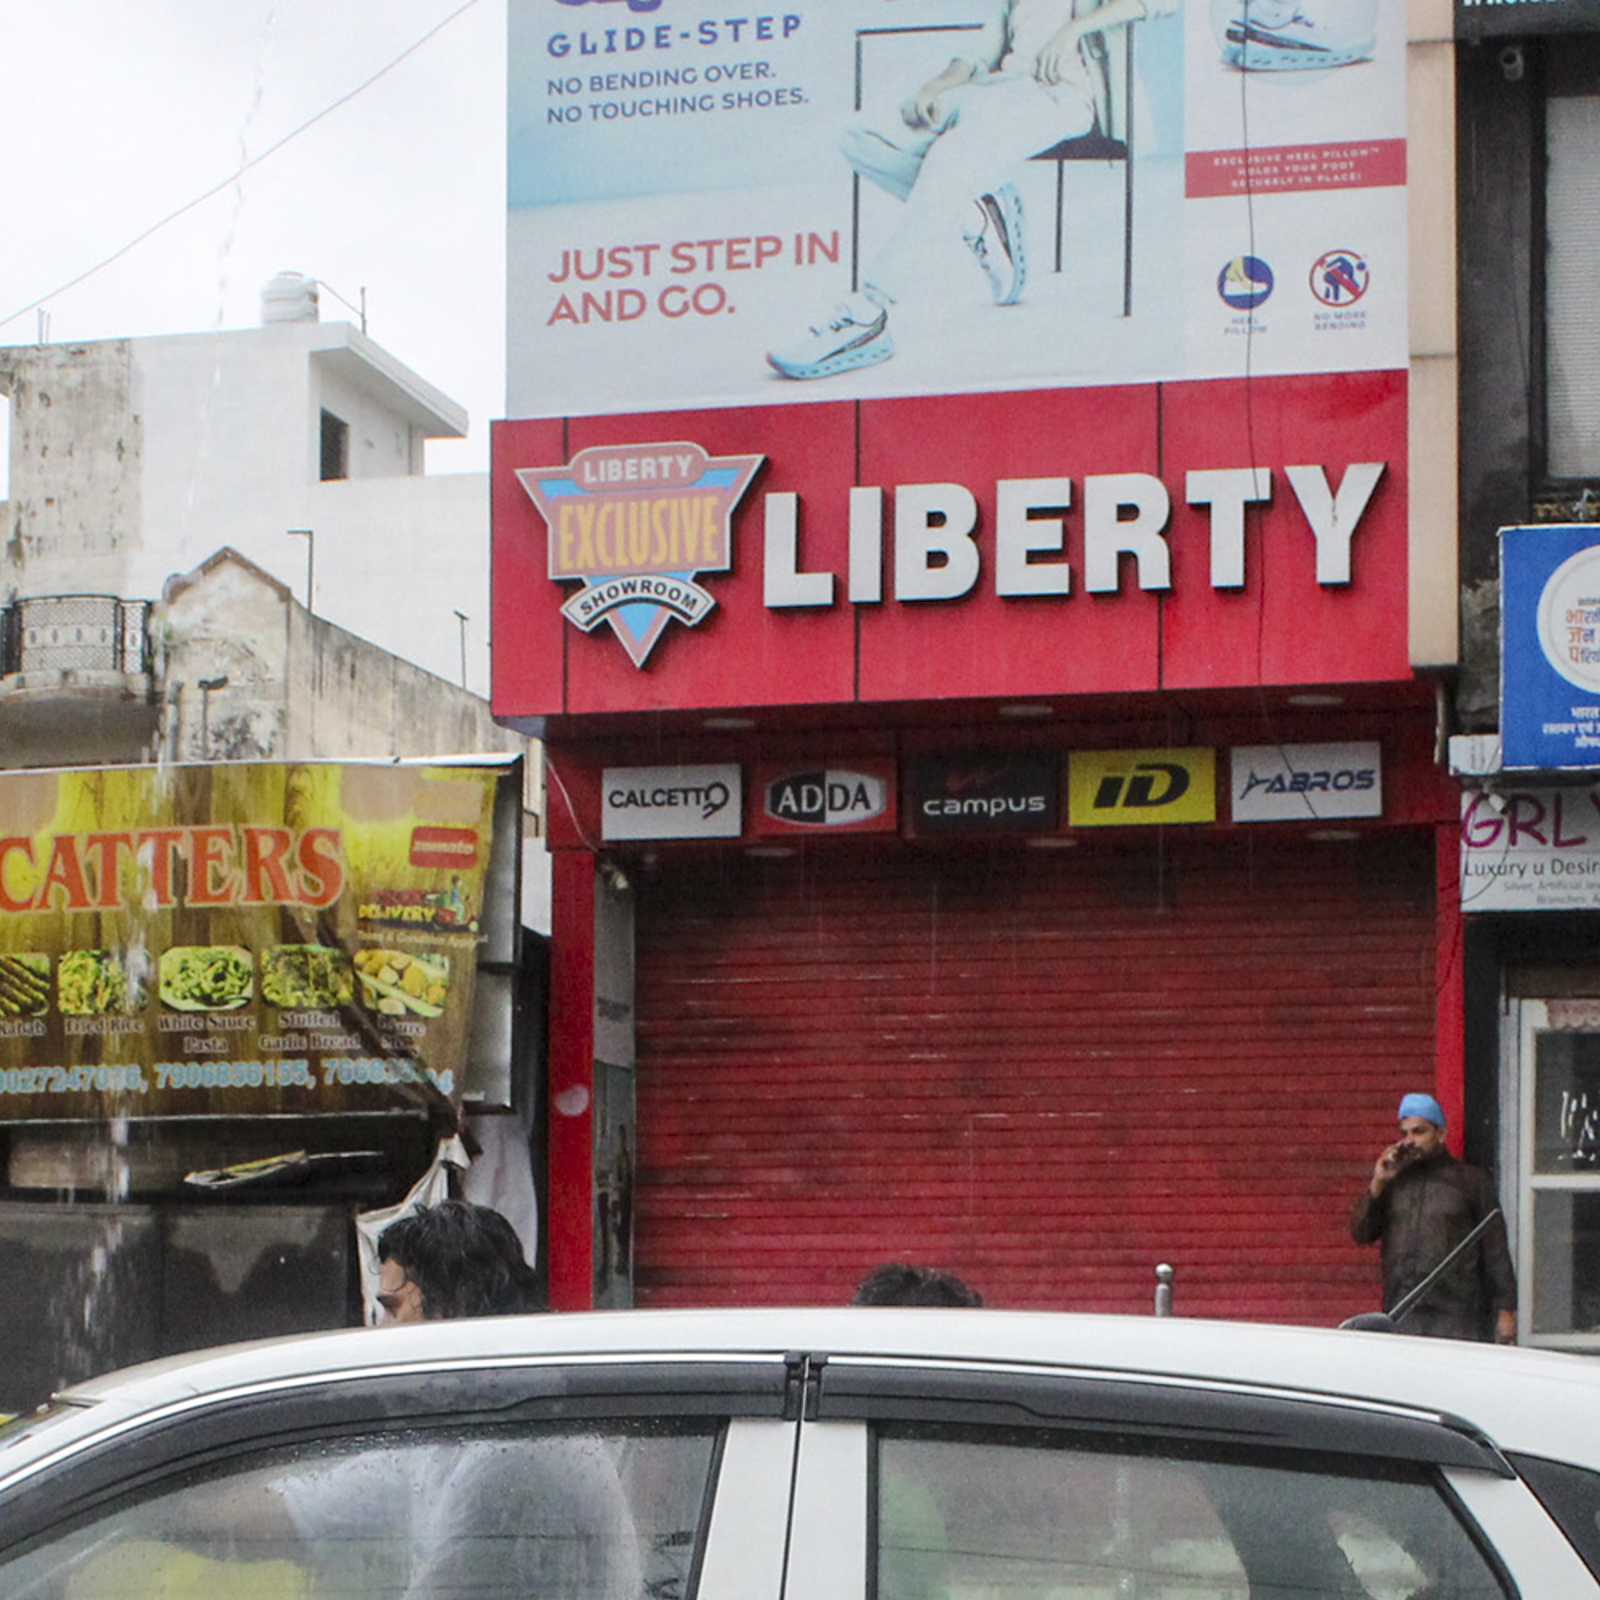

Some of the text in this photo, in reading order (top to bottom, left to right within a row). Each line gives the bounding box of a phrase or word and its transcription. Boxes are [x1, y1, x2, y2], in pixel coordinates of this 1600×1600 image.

[546, 14, 802, 58] GLIDE-STEP
[547, 61, 776, 96] NO BENDING OVER.
[547, 87, 810, 124] NO TOUCHING SHOES.
[1213, 153, 1282, 167] EXCLUSIVE
[1286, 151, 1318, 161] HEEL
[1238, 160, 1356, 176] HOLDS YOUR FOOT
[1231, 176, 1294, 188] SECURELY
[1299, 175, 1312, 183] IN
[546, 230, 841, 284] JUST STEP IN
[546, 282, 737, 327] AND GO.
[1231, 317, 1259, 326] HEEL
[1313, 310, 1367, 321] NO MORE
[1314, 321, 1367, 332] BENDING
[582, 454, 694, 484] LIBERTY
[558, 496, 720, 572] EXCLUSIVE
[762, 460, 1388, 611] LIBERTY
[579, 578, 699, 616] SHOWROOM
[1263, 768, 1377, 794] ABROS
[607, 781, 731, 819] CALCETTO
[776, 782, 873, 814] ADDA
[922, 796, 1048, 818] campus
[1463, 858, 1526, 879] Luxury
[1533, 863, 1545, 876] u
[358, 903, 436, 923] DELIVERY
[65, 1017, 147, 1036] Fried Rice
[157, 1013, 258, 1033] White Sauce
[278, 1010, 342, 1028] Stuffed
[183, 1035, 230, 1054] Pasta
[309, 1032, 362, 1050] Bread
